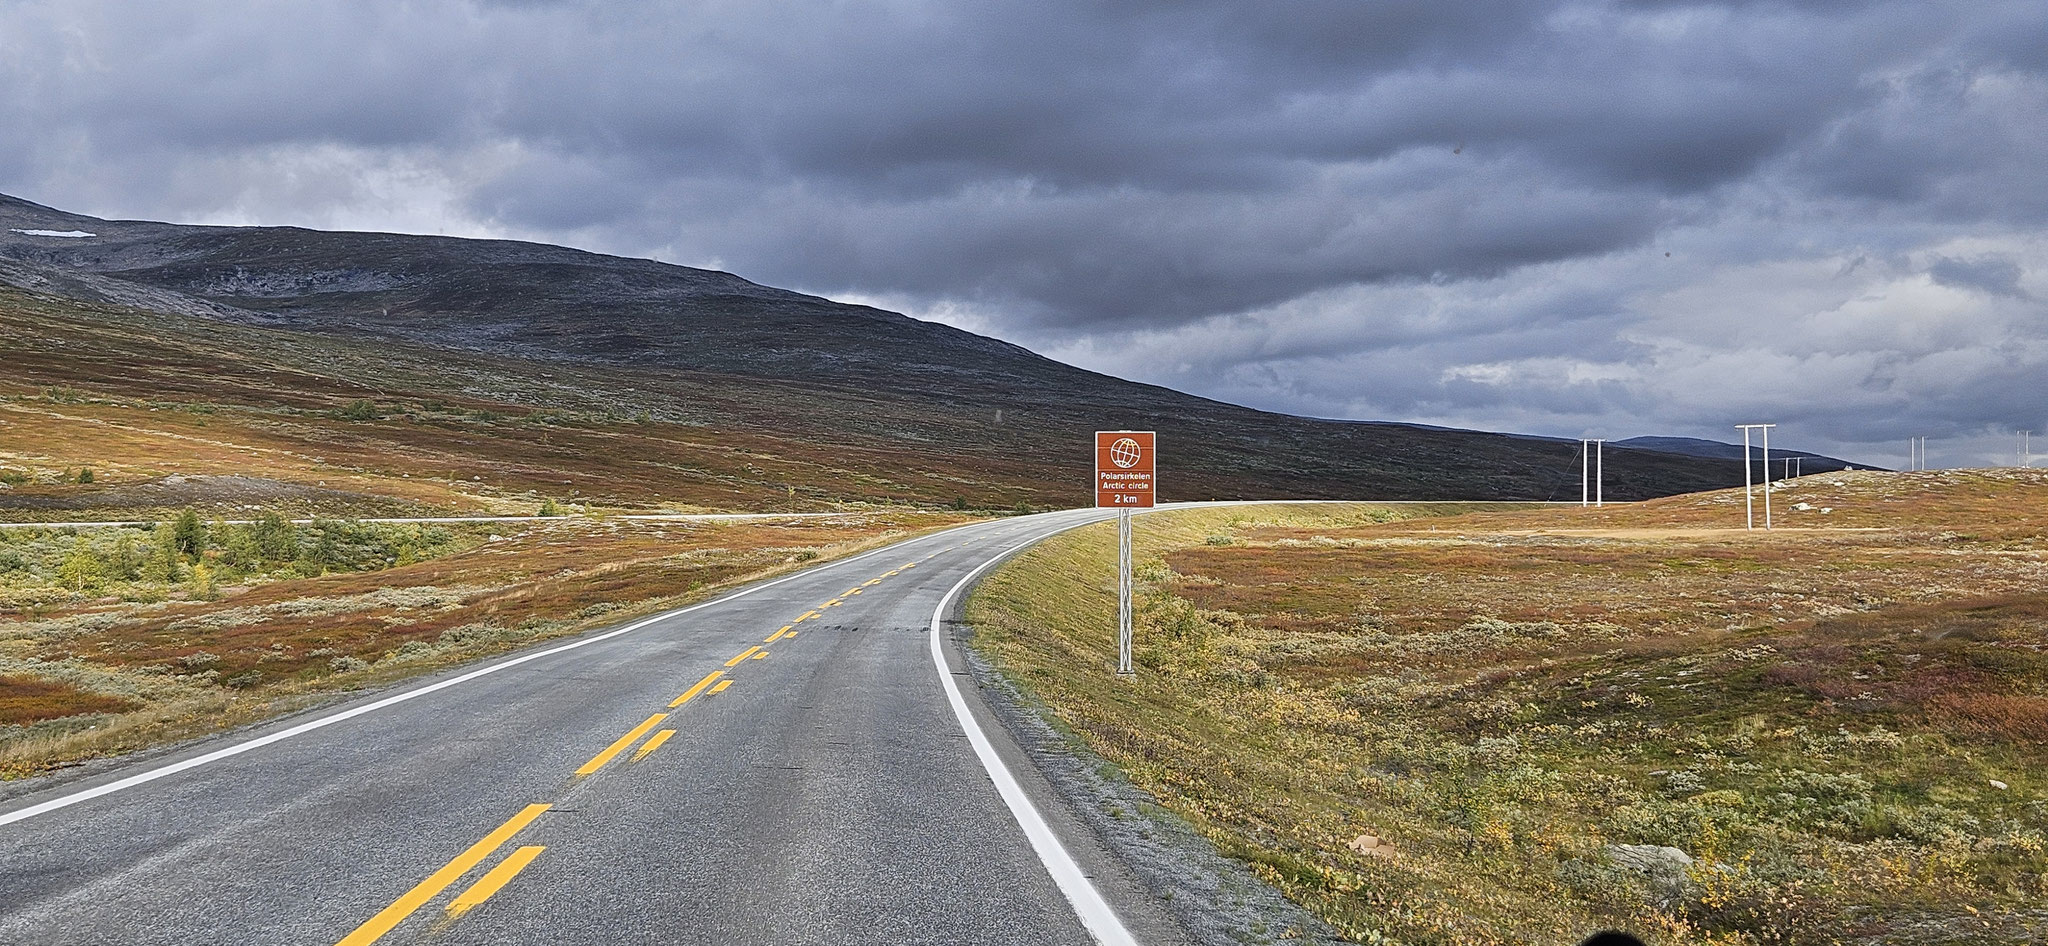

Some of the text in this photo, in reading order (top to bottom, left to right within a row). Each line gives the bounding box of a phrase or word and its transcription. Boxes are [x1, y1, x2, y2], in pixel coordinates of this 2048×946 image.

[1101, 472, 1151, 480] Polarsirkelen
[1114, 494, 1137, 503] 2 km
